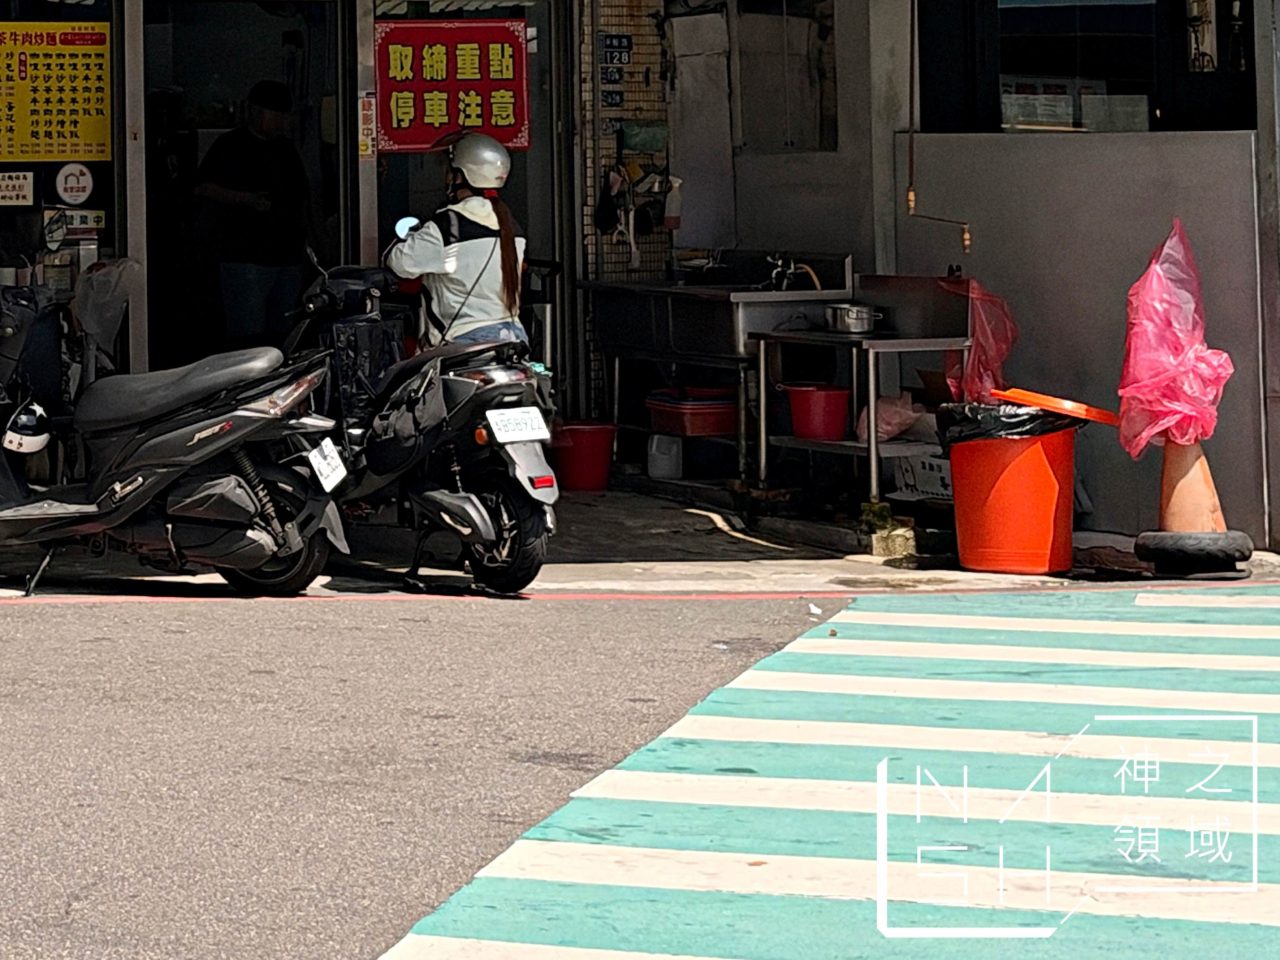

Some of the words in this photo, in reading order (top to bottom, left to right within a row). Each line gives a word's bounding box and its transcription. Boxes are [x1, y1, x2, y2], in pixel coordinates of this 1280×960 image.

[388, 43, 514, 81] 取締重點
[606, 52, 629, 64] 128
[390, 90, 516, 128] 停車注意
